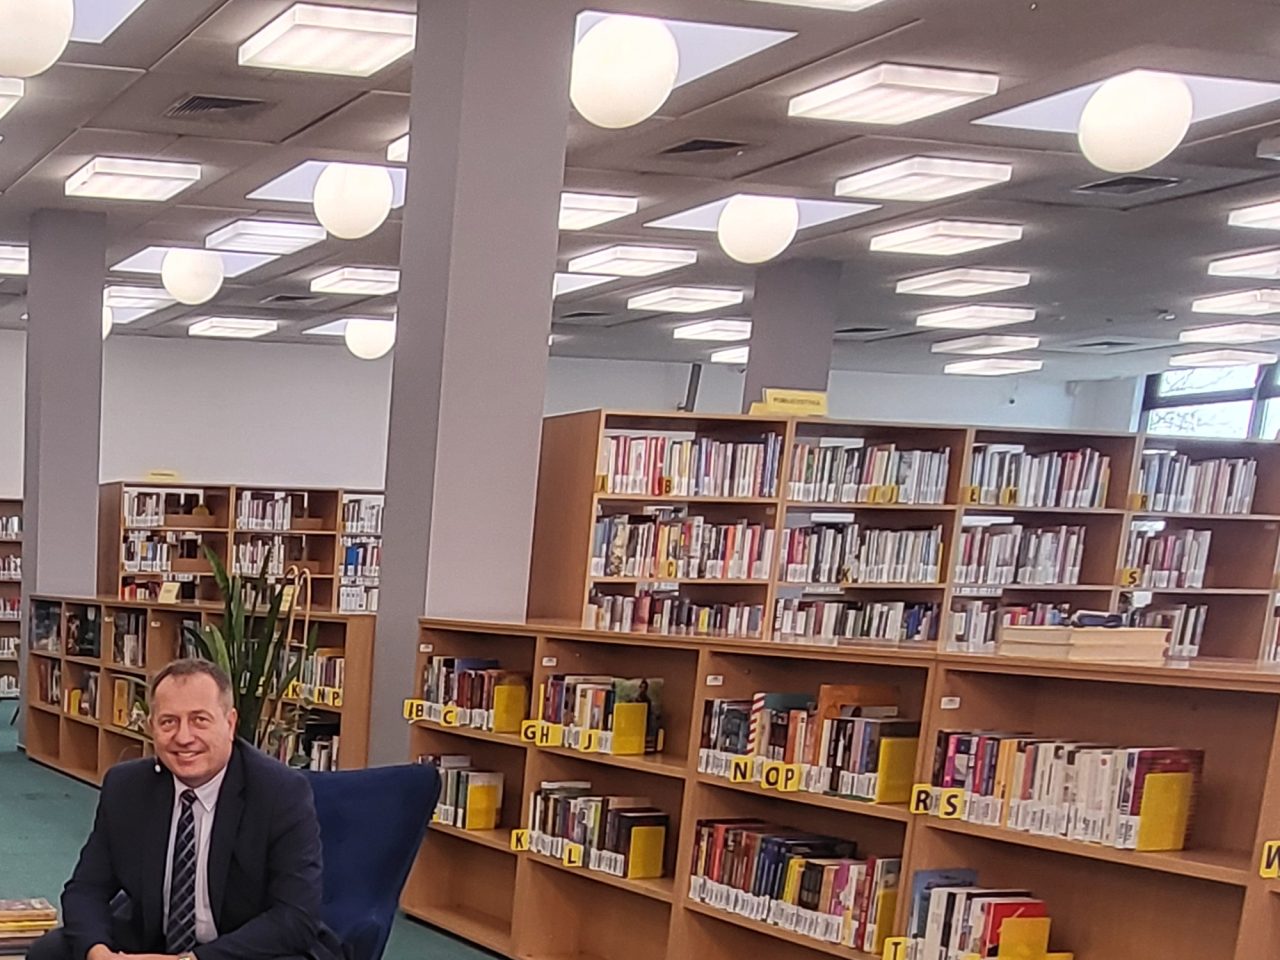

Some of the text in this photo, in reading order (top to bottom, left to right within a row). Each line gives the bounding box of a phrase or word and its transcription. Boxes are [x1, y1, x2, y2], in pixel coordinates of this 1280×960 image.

[667, 562, 674, 576] C
[1128, 571, 1137, 584] S
[292, 684, 299, 696] K
[318, 688, 325, 702] N
[333, 692, 340, 705] P
[415, 704, 424, 717] B
[443, 711, 453, 725] C
[524, 725, 536, 740] G
[540, 726, 549, 743] H
[584, 734, 592, 750] J
[733, 762, 748, 781] N
[765, 766, 780, 786] O
[784, 768, 795, 789] P
[915, 789, 930, 812] R
[944, 794, 958, 816] S
[515, 832, 524, 849] K
[567, 848, 576, 864] L
